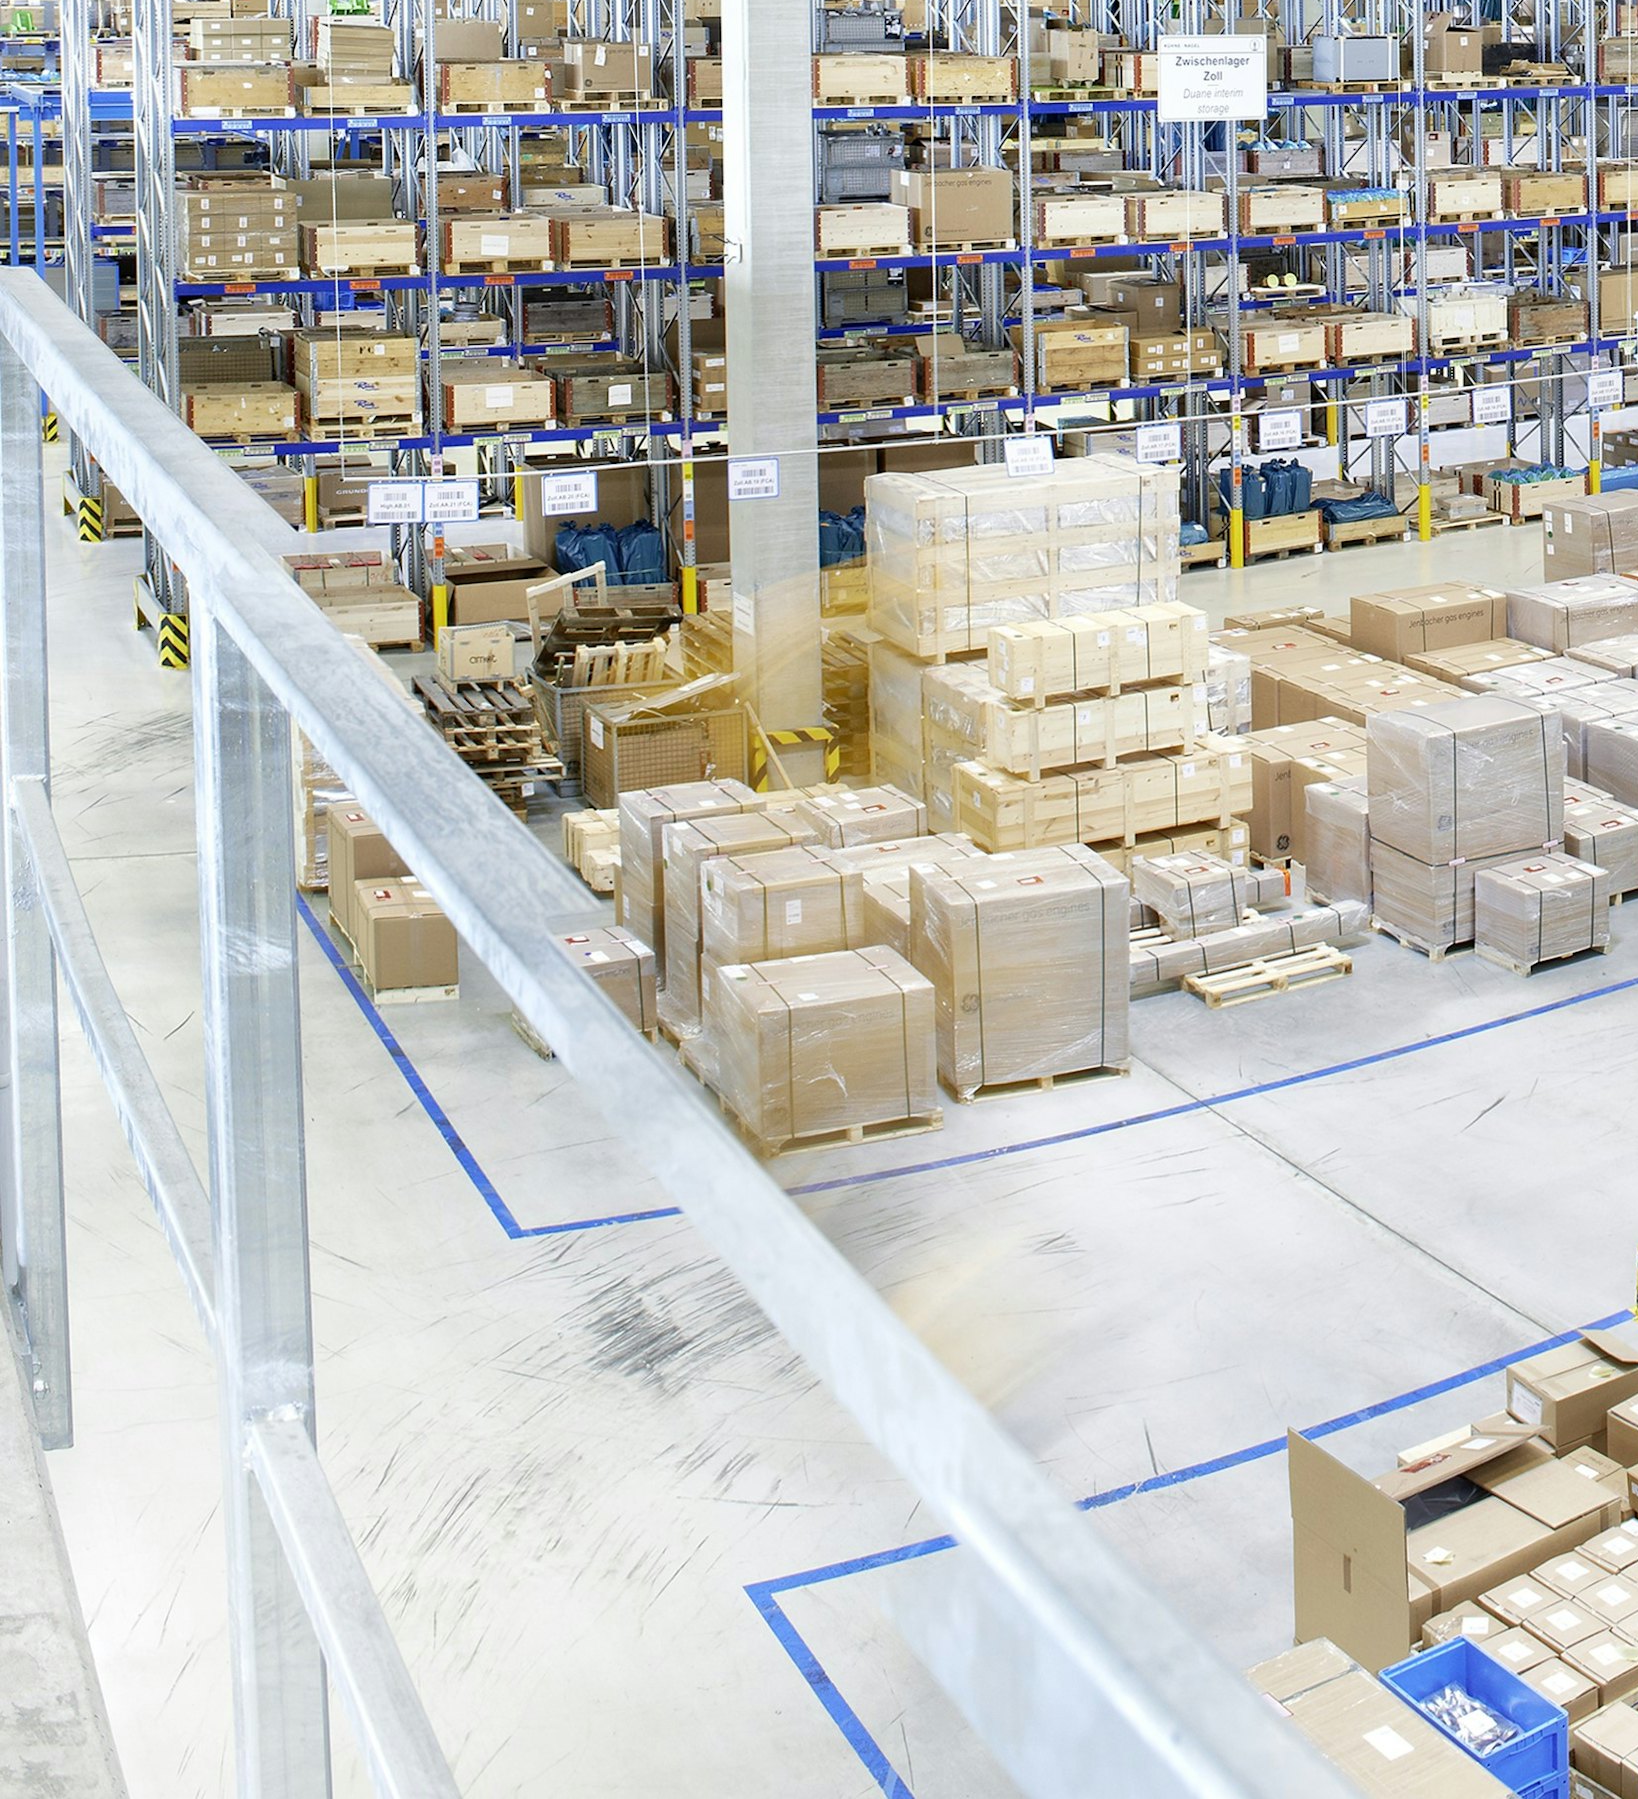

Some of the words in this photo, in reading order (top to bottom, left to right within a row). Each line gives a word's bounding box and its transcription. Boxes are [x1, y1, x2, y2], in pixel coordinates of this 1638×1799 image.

[1176, 56, 1250, 68] Zwischenlager
[1203, 71, 1222, 81] Zoll
[1183, 88, 1212, 99] Duane
[1198, 104, 1229, 116] storage
[1445, 615, 1457, 624] gas
[1458, 610, 1484, 621] engines
